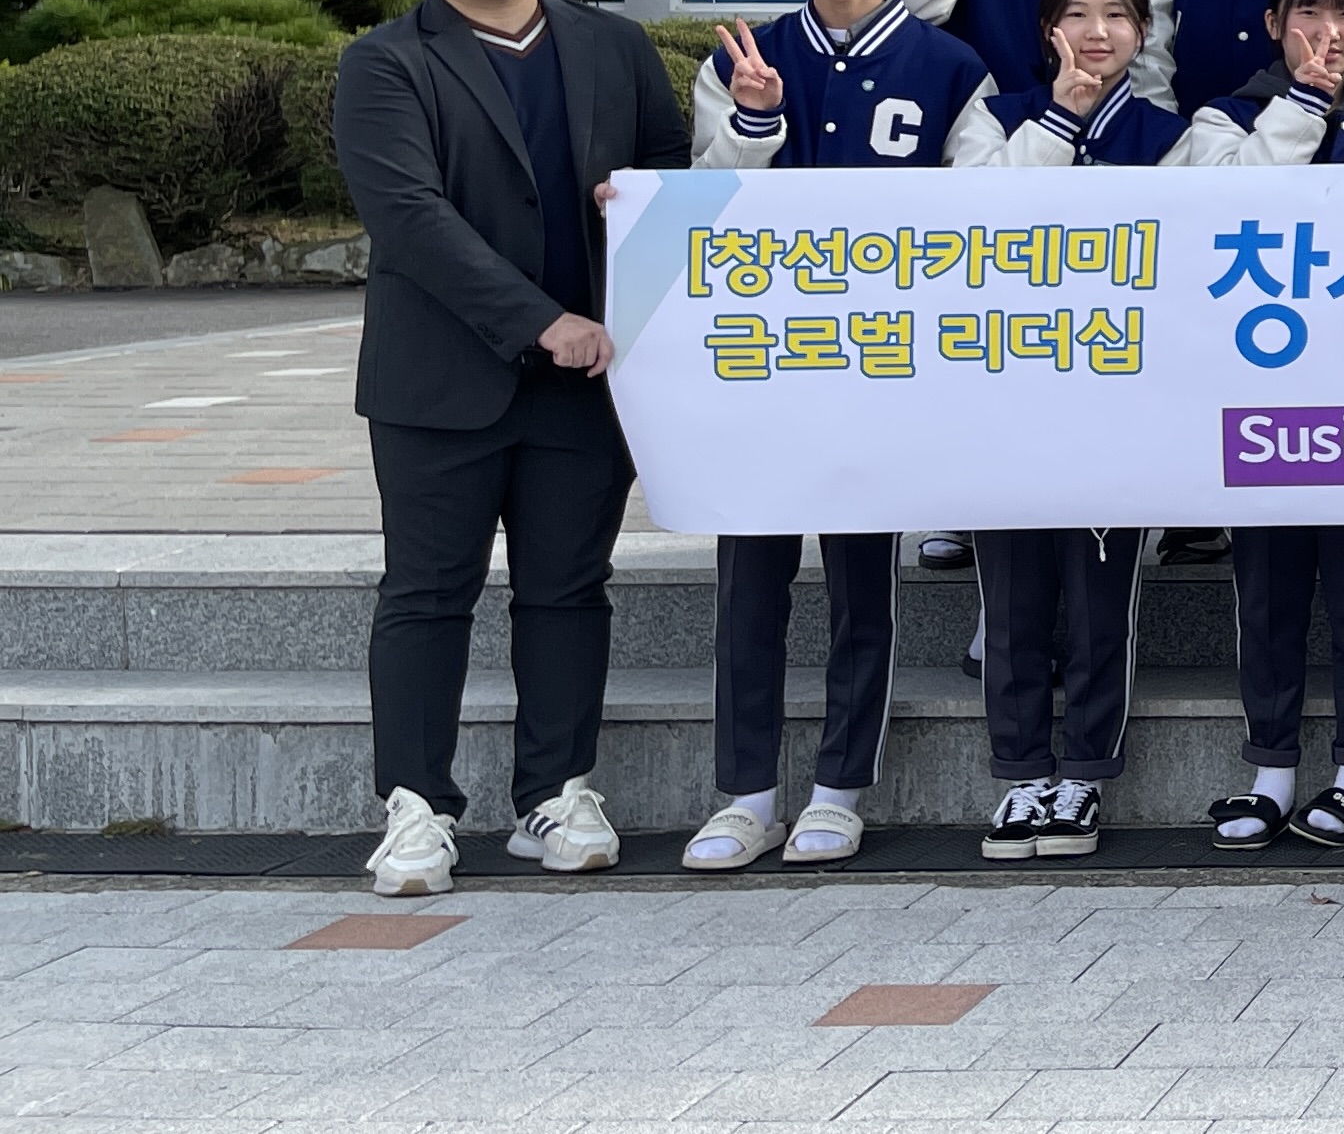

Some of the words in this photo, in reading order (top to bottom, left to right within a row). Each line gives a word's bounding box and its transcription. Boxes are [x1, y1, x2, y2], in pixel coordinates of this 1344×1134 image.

[869, 97, 924, 158] C
[687, 220, 1160, 297] [창선아카데미]
[704, 311, 916, 381] 글로벌
[938, 307, 1144, 375] 리더십
